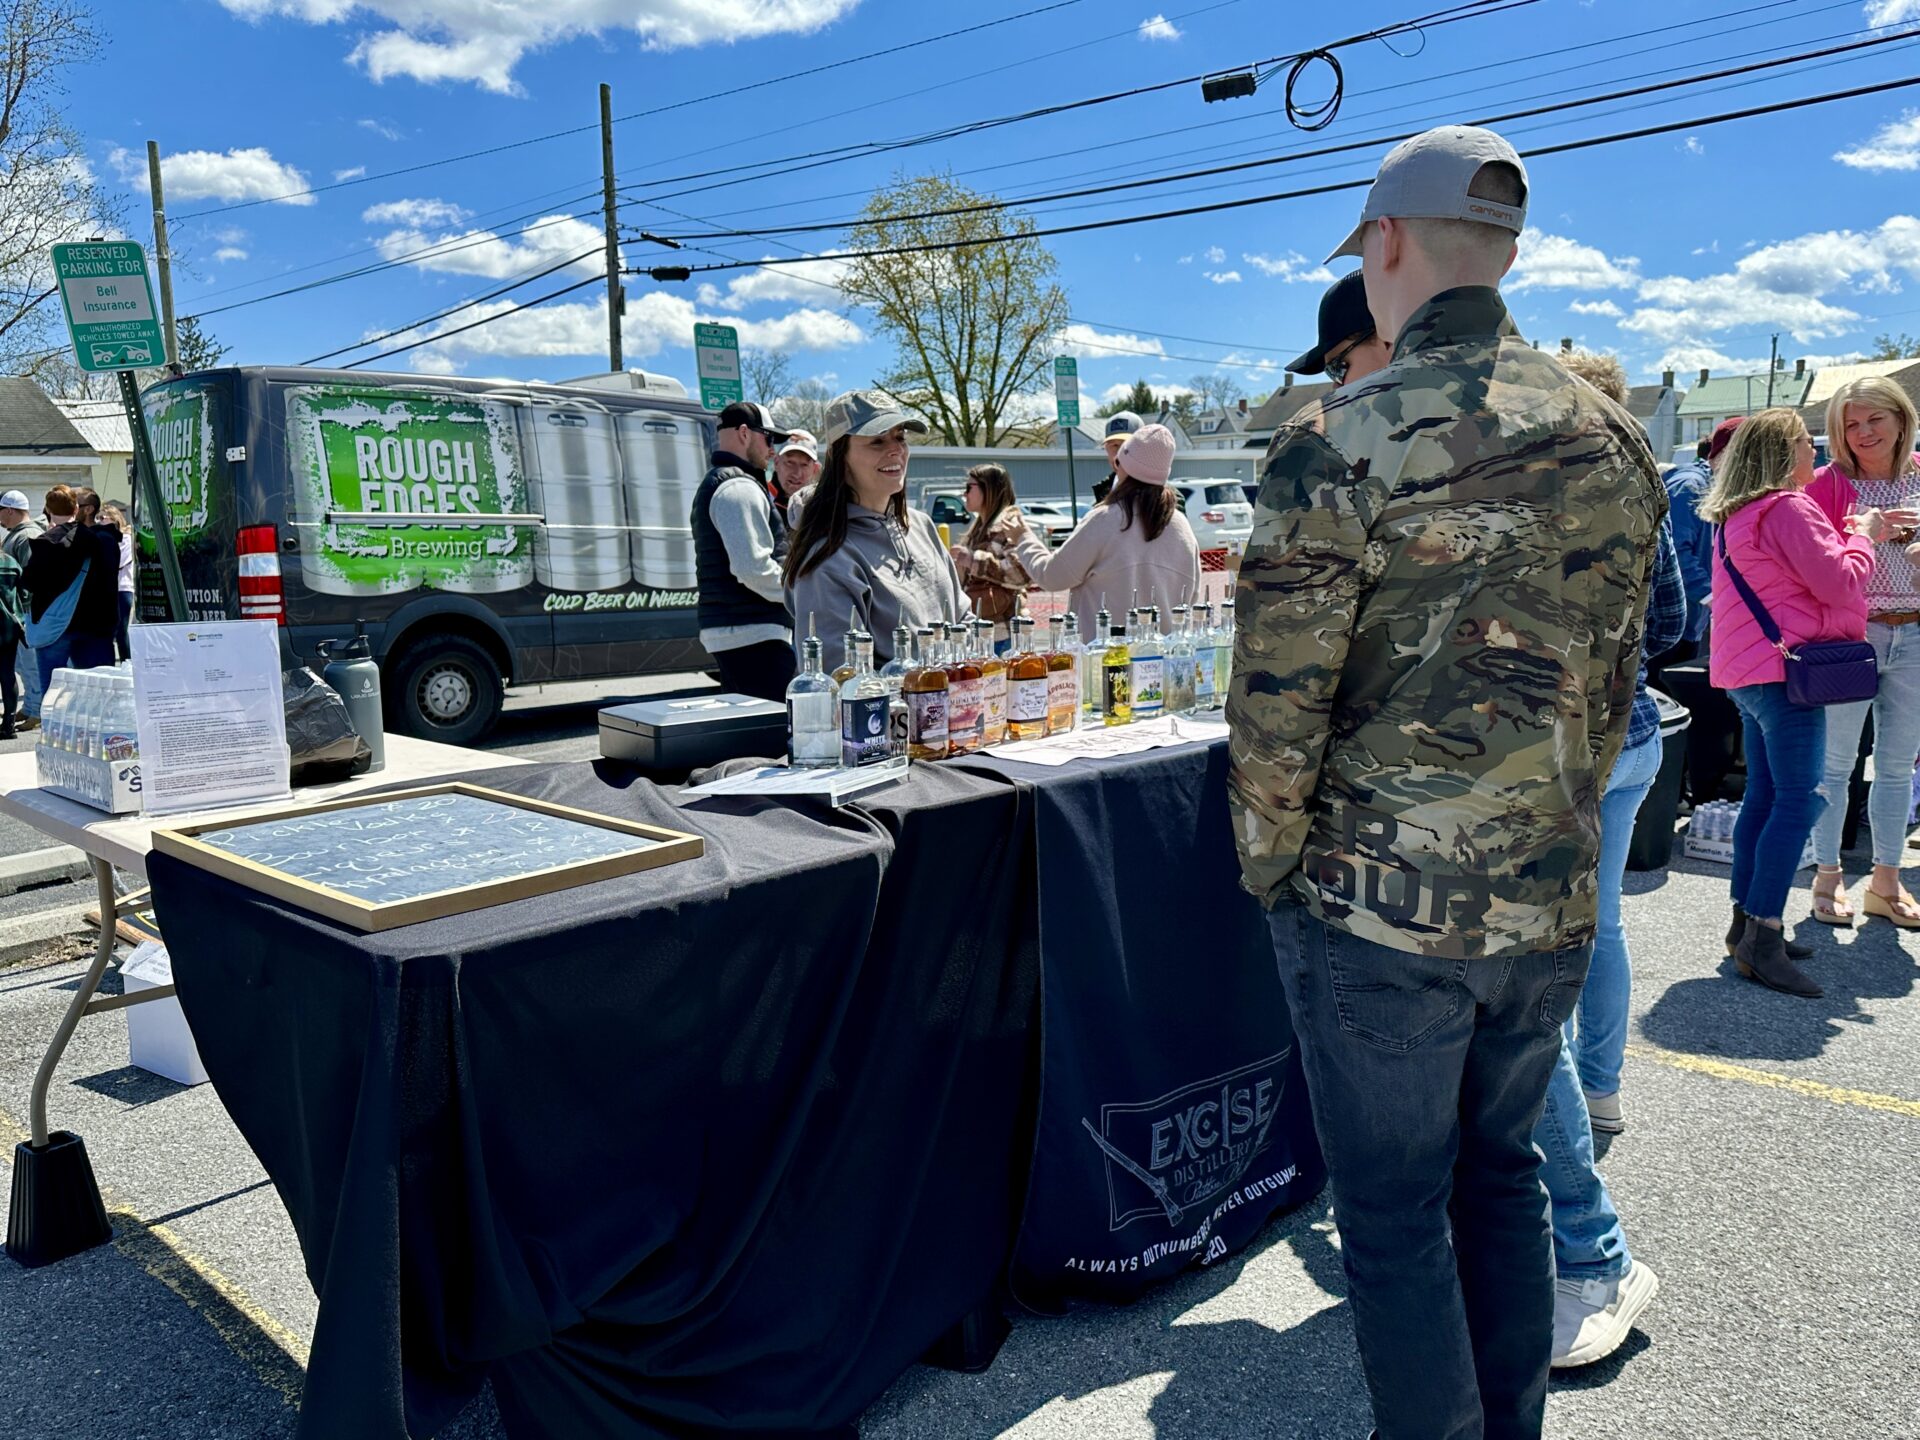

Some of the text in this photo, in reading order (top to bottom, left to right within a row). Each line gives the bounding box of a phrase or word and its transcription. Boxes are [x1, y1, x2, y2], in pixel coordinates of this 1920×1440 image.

[1468, 203, 1514, 222] carhartt
[67, 246, 128, 260] RESERVED
[60, 260, 142, 276] PARKING FOR
[96, 285, 118, 297] Bell
[83, 300, 137, 313] Insurance
[78, 330, 156, 342] VEHICLES TOWED AWAY
[89, 322, 141, 333] UNAUTHORIZED
[354, 435, 478, 483] ROUGH
[155, 459, 192, 504] DGES
[360, 480, 483, 530] EDGES
[389, 536, 483, 561] Brewing
[543, 590, 700, 611] COLD BEER ON WHEELS
[202, 609, 227, 621] BEER
[336, 812, 448, 830] Vodka
[199, 819, 350, 847] Pickle
[1150, 1078, 1274, 1170] EXCISE
[1173, 1138, 1253, 1187] DISTILLERY
[1065, 1256, 1138, 1273] ALWAYS
